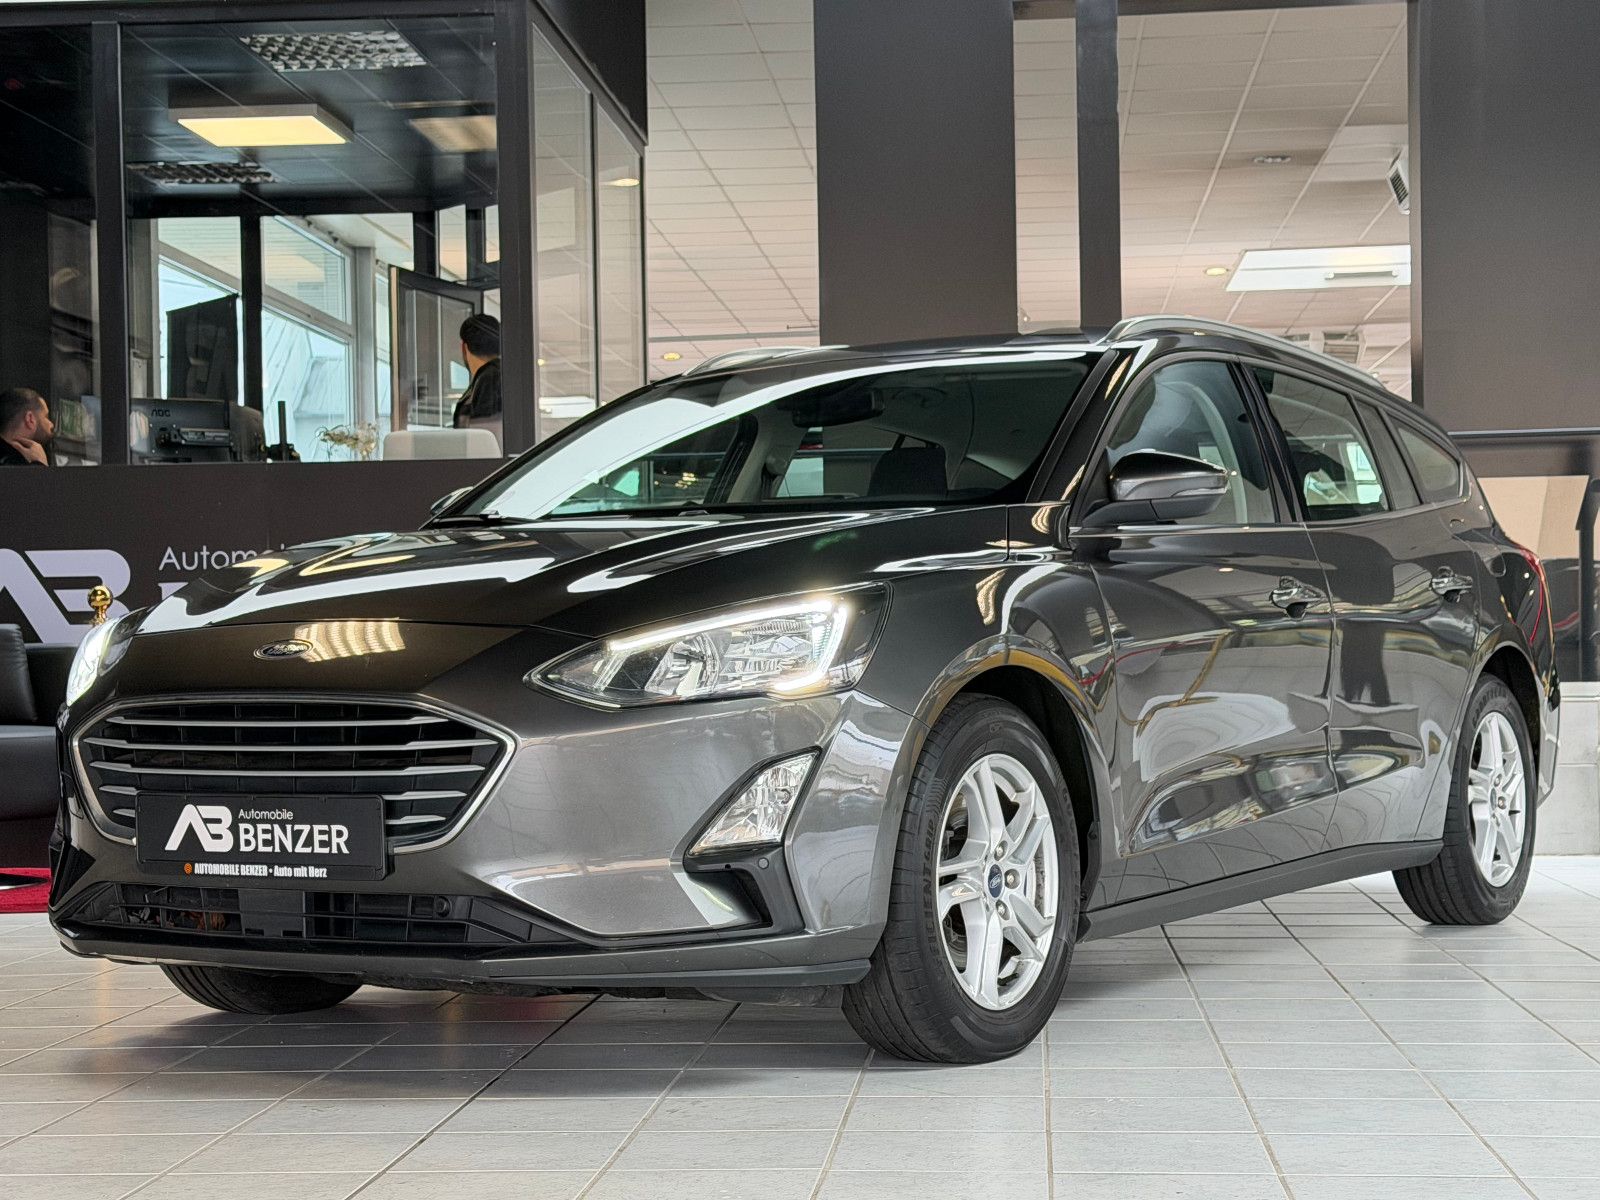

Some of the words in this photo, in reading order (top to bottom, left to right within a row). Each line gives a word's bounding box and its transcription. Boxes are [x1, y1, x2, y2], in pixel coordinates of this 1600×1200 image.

[238, 808, 294, 820] Automobile
[165, 804, 233, 852] AB
[238, 823, 350, 854] BENZER
[194, 863, 240, 876] AUTOMOBILE
[273, 865, 293, 877] Auto
[293, 866, 308, 878] mit
